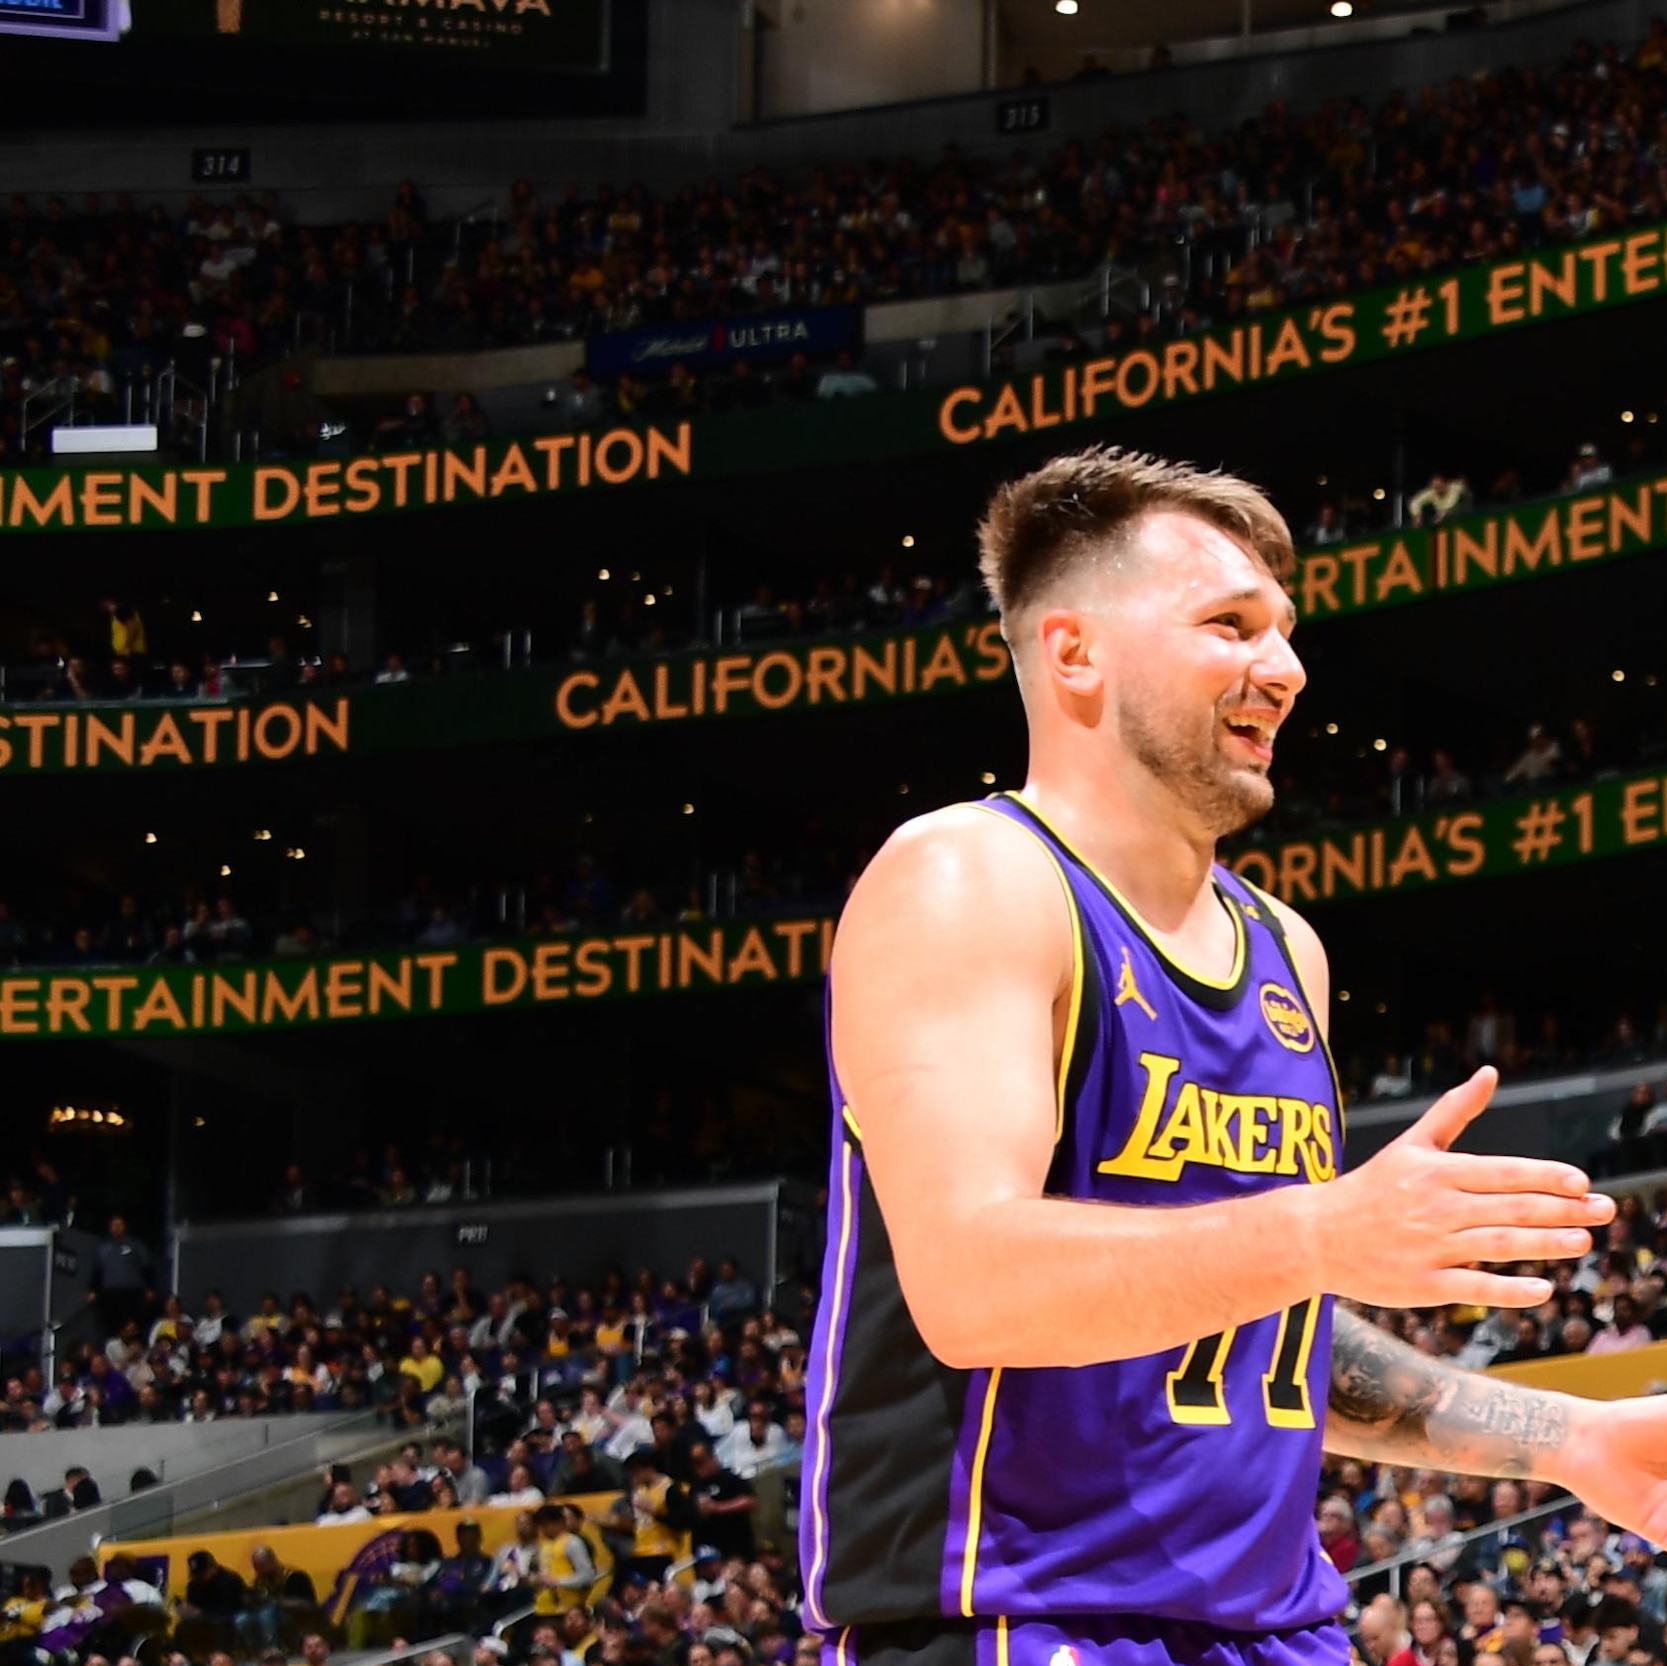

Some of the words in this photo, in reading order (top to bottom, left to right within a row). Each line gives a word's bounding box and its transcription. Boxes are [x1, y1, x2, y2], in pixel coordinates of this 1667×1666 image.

[202, 156, 242, 177] 314
[728, 321, 809, 350] ULTRA
[939, 304, 1356, 443] CALIFORNIA'S
[1382, 279, 1459, 347] #1
[0, 470, 227, 526] MENT
[253, 422, 691, 520] DESTINATION
[556, 621, 1009, 728] CALIFORNIA'S
[1220, 813, 1484, 906] ORNIA'S
[1513, 794, 1592, 862] #1
[0, 953, 457, 1033] ERTAINMENT
[1098, 1051, 1335, 1185] LAKERS
